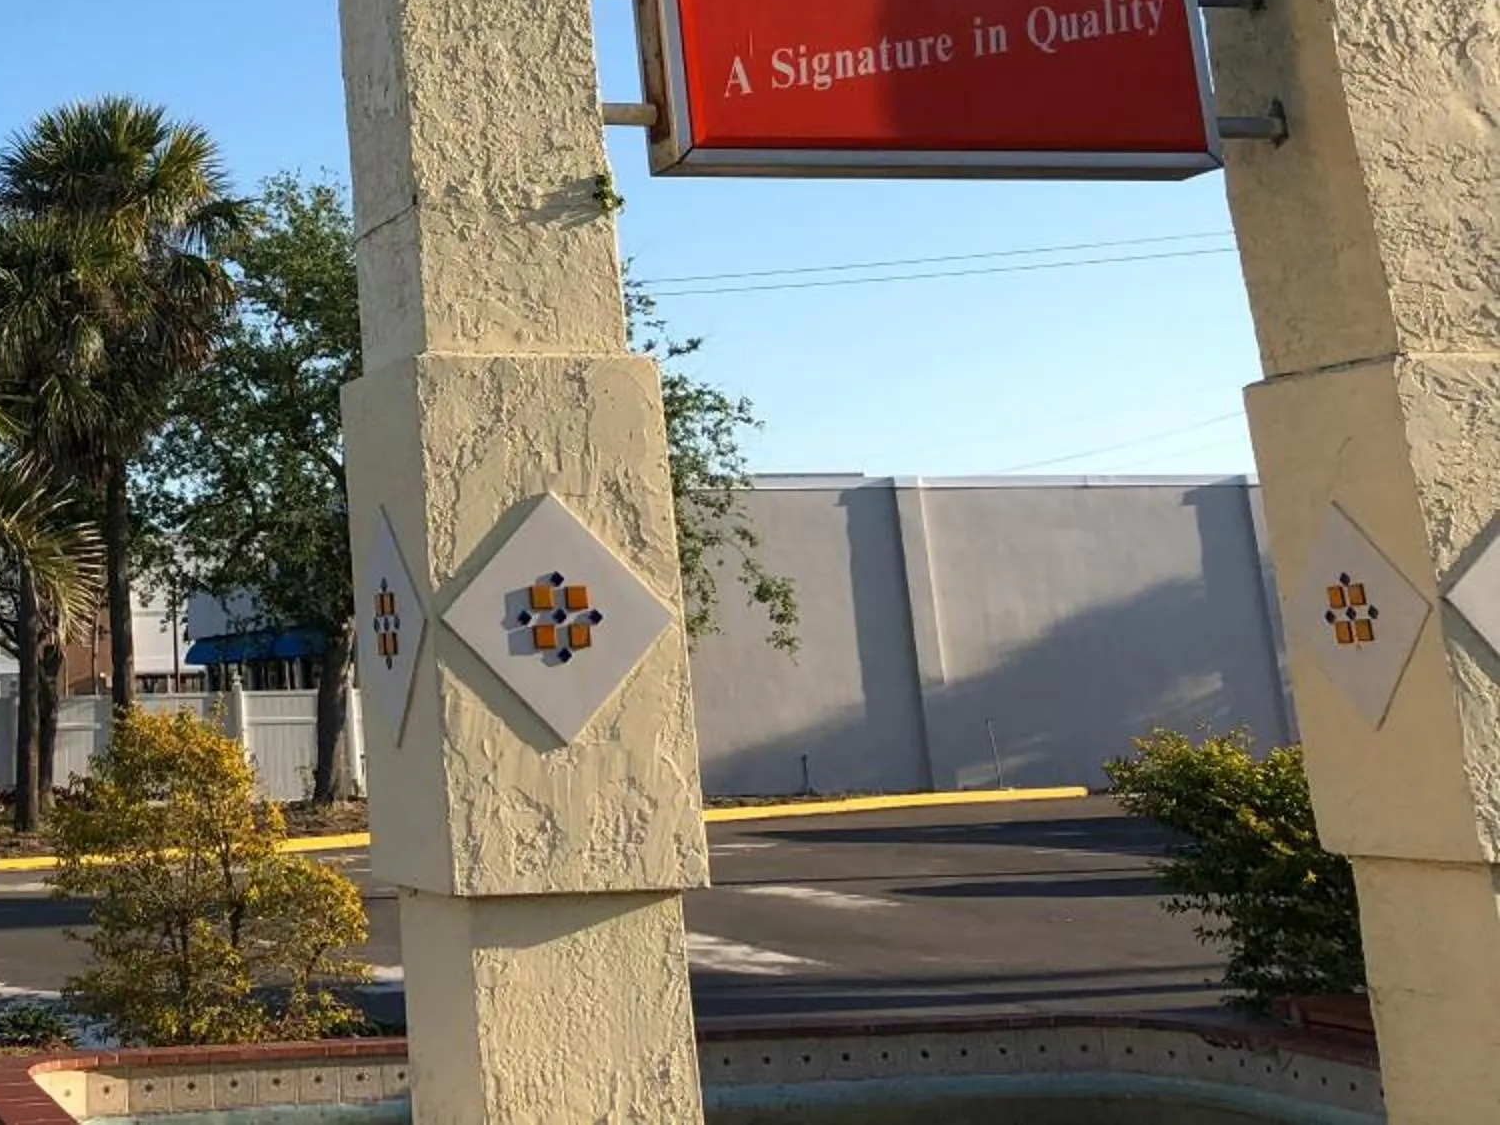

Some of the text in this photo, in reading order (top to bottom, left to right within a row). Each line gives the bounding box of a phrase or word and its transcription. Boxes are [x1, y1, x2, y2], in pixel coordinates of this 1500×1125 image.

[724, 55, 753, 97] A
[771, 33, 953, 91] Signature
[973, 17, 1009, 57] in
